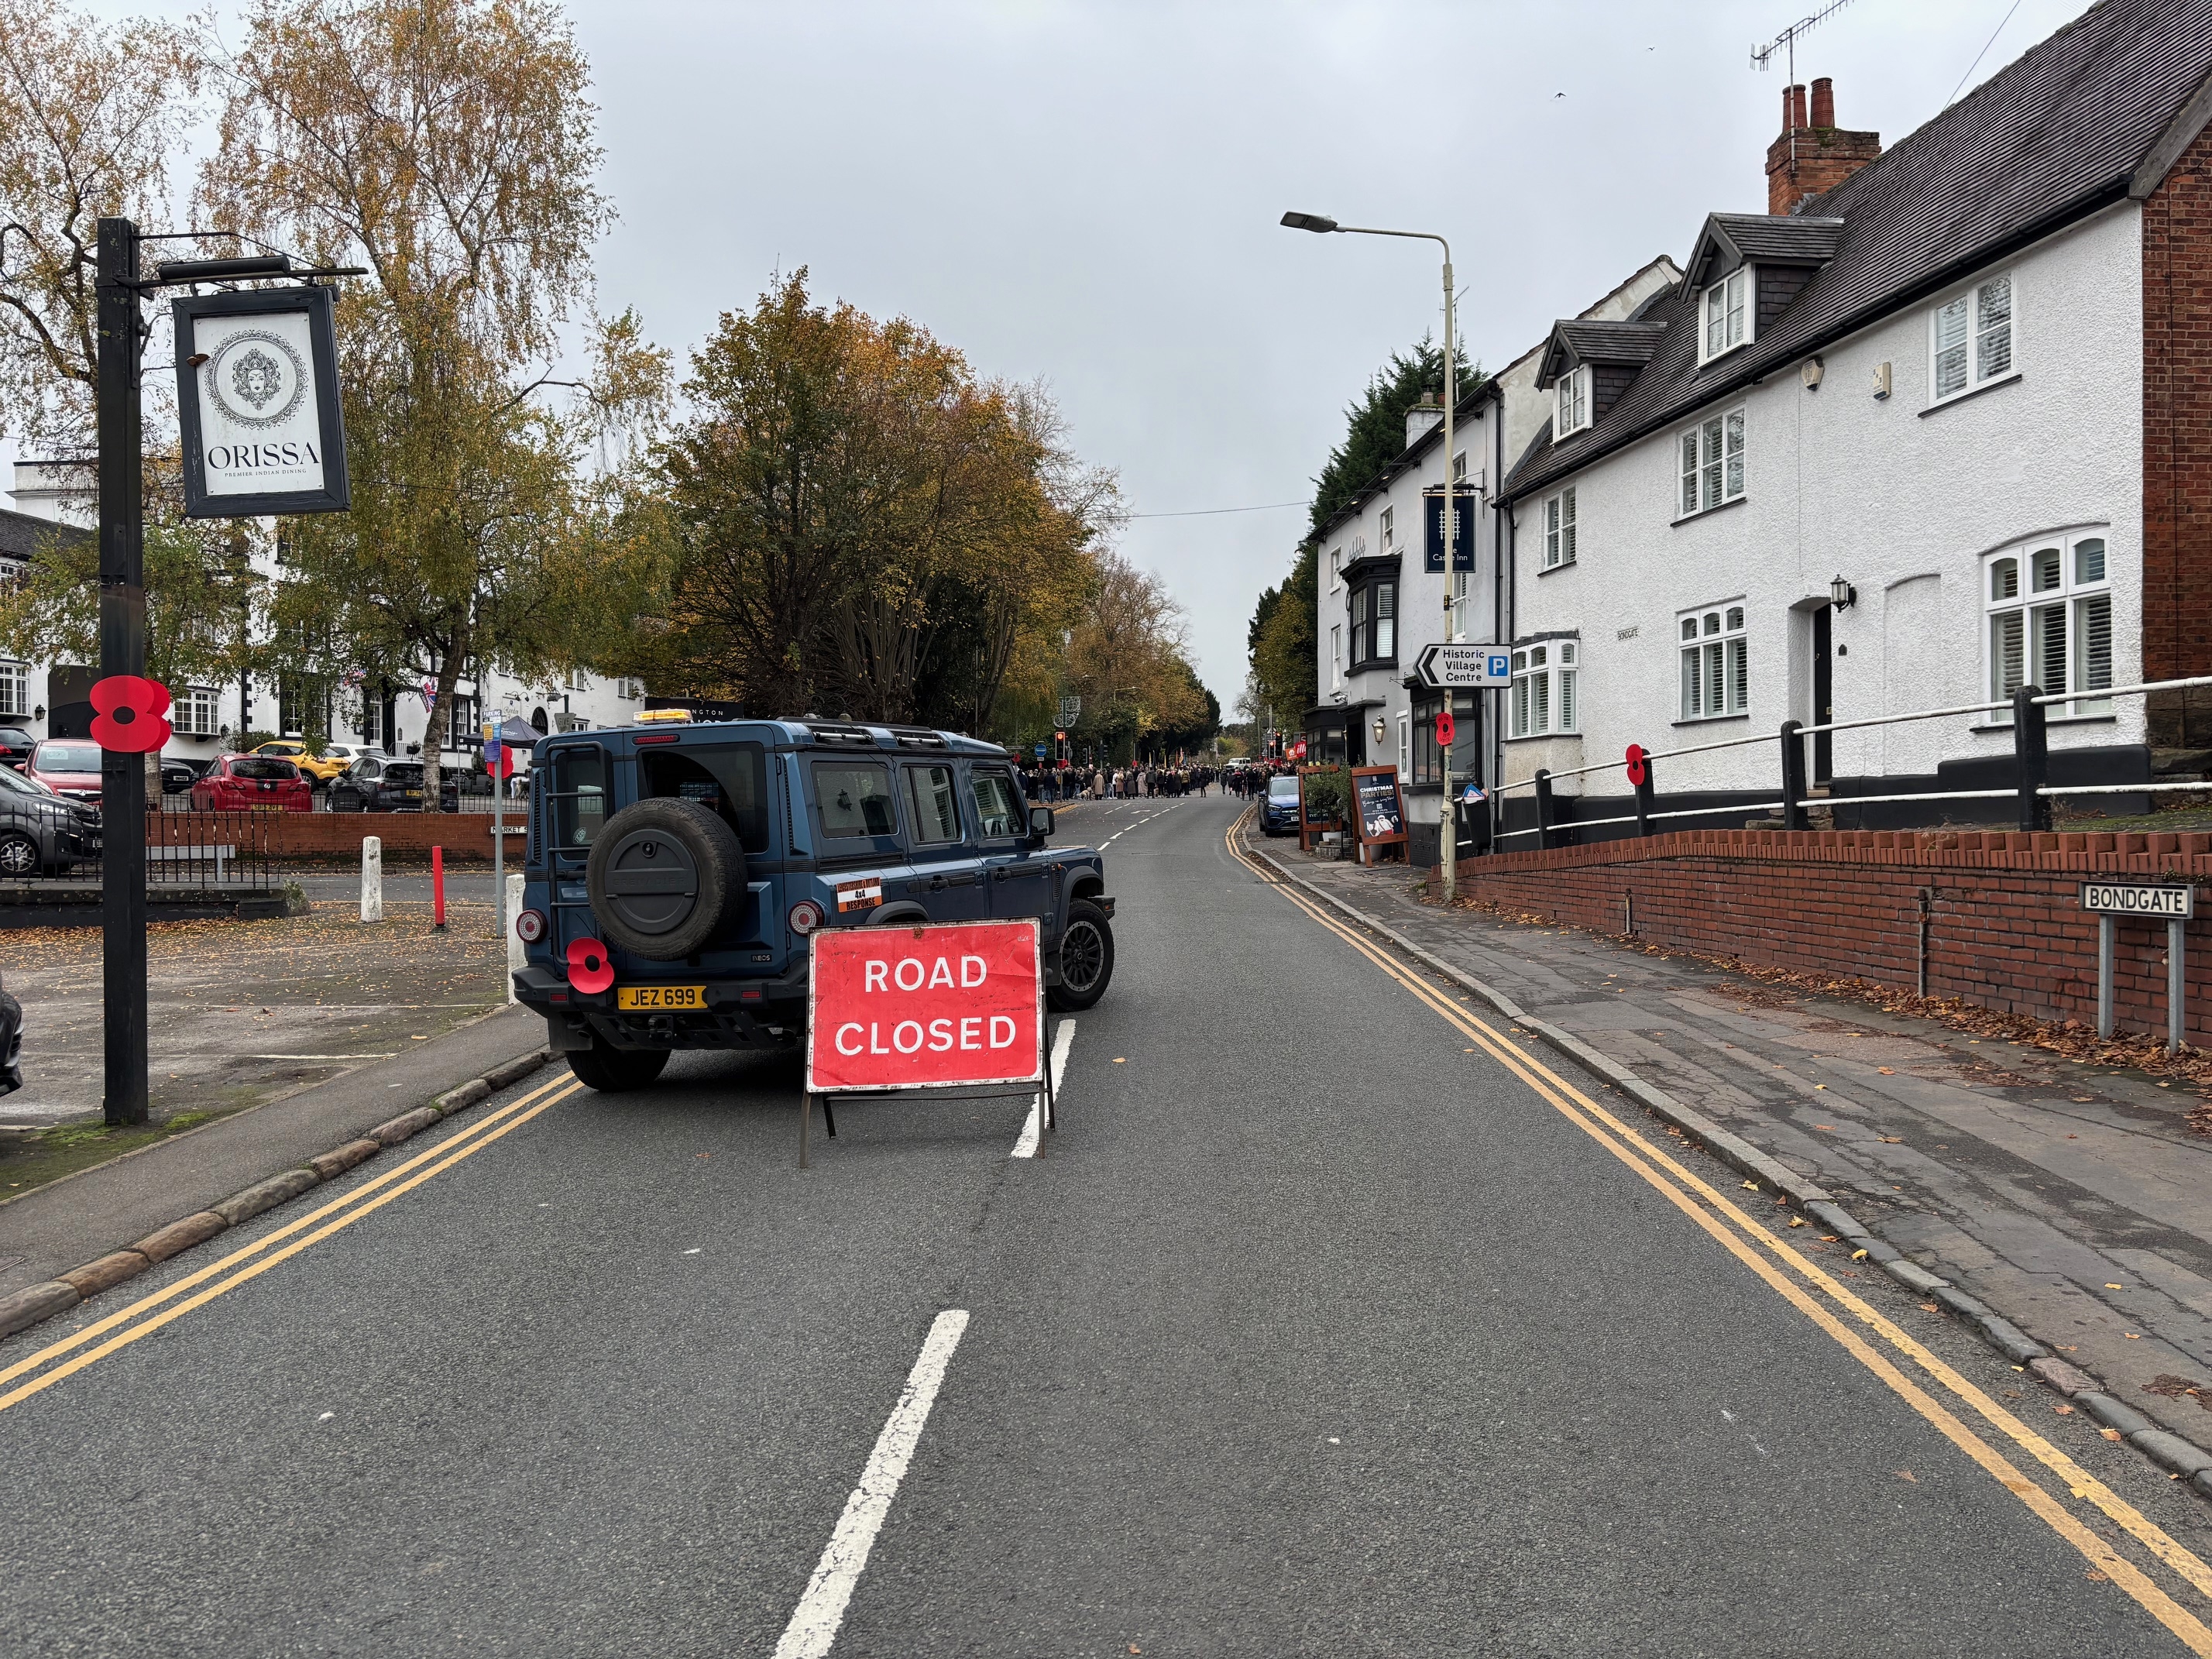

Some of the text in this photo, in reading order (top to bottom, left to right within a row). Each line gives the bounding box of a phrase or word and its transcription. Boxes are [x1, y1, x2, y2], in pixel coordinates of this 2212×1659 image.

[208, 441, 320, 469] ORISSA
[1443, 649, 1485, 658] Historic
[1445, 658, 1505, 675] Village P
[1446, 672, 1482, 682] Centre
[558, 717, 570, 726] GIVE
[1360, 785, 1393, 793] CHRISTMAS
[1361, 789, 1394, 799] PARTIES!
[855, 889, 865, 899] 4x4
[2090, 888, 2183, 912] BONDGATE
[847, 897, 875, 910] RESPONSE
[865, 955, 988, 993] ROAD
[630, 988, 696, 1006] JEZ 699
[835, 1015, 1016, 1056] CLOSED
